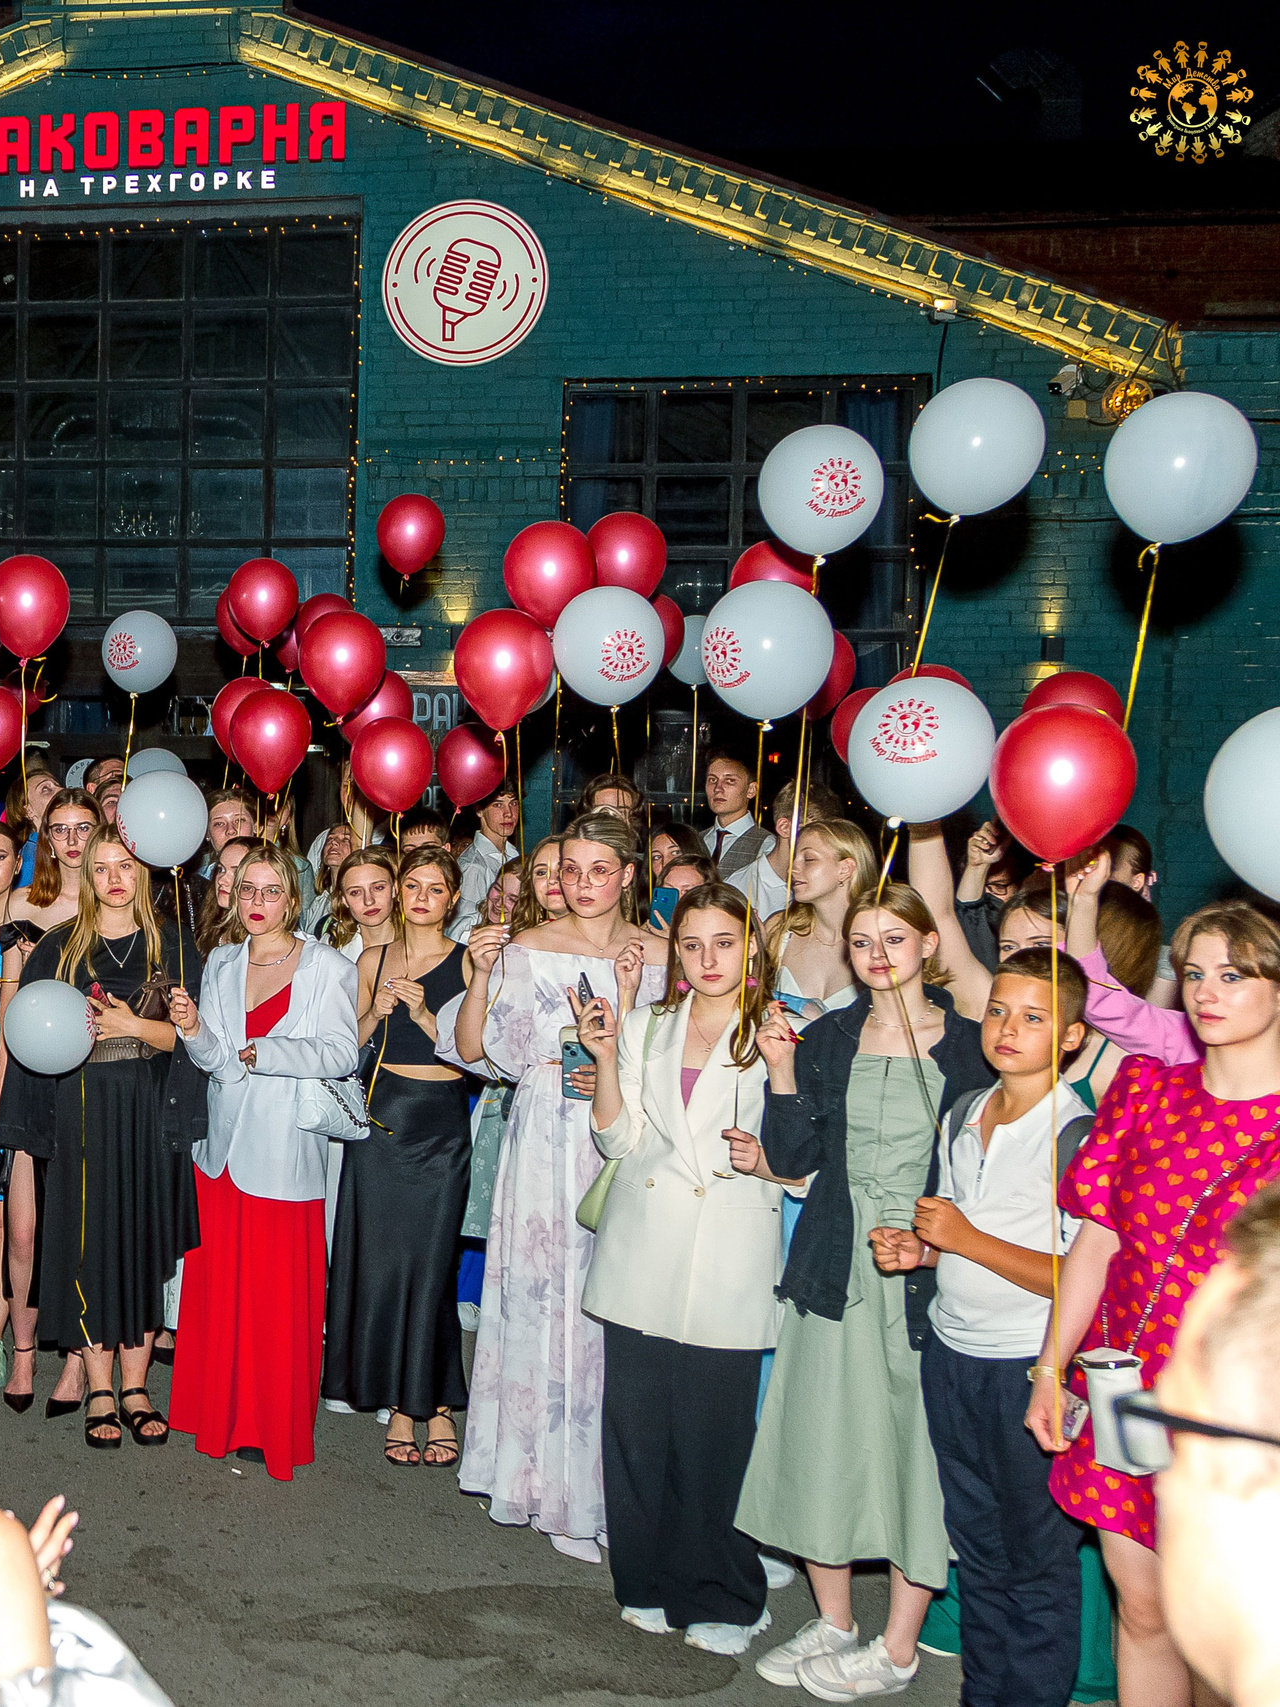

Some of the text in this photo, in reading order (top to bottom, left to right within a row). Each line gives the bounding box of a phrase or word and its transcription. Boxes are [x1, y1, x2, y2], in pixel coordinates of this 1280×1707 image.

[19, 168, 277, 199] НА ТРЕХГОРКЕ
[805, 496, 867, 518] Мир Детства
[597, 667, 617, 682] Мир
[869, 736, 938, 764] Мир Детства
